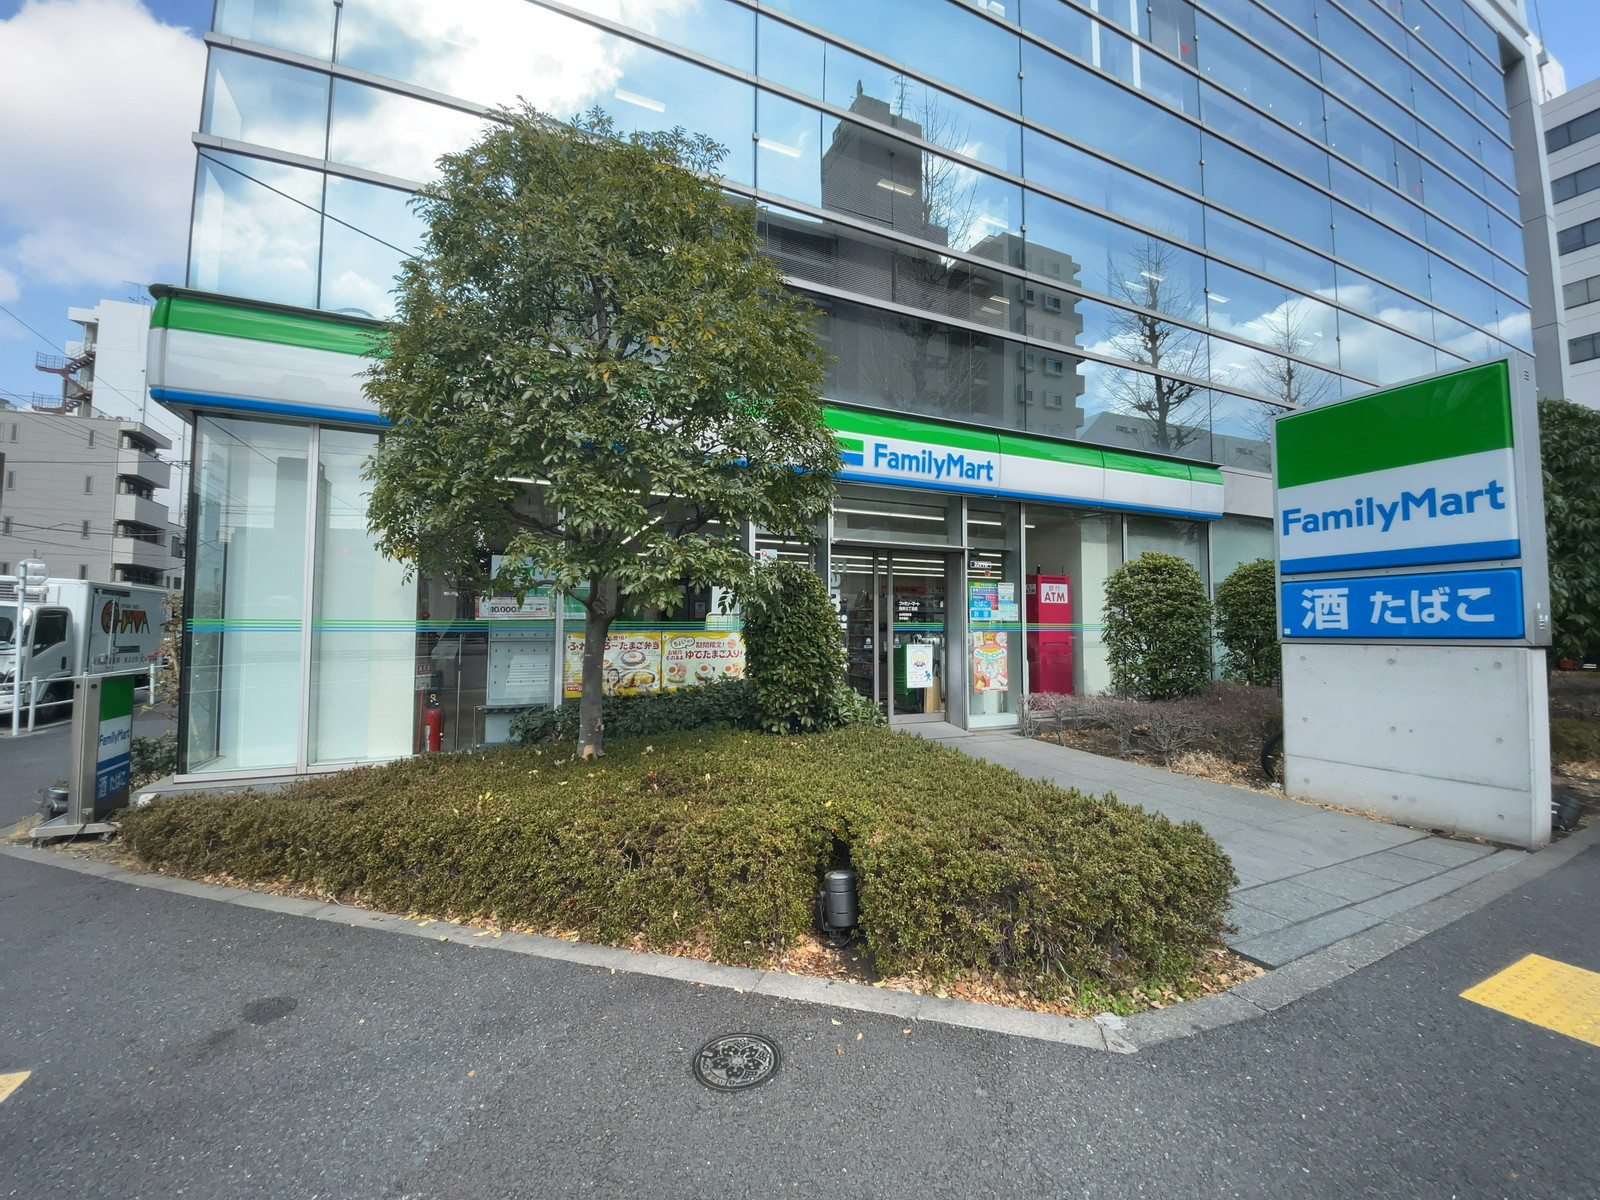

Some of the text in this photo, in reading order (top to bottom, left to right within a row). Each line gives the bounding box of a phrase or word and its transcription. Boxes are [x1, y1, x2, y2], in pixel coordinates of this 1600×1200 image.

[874, 443, 994, 481] FamilyMart
[1282, 479, 1506, 536] FamilyMart
[1044, 592, 1066, 602] ATM
[1301, 586, 1495, 630] 酒 たばこ
[685, 650, 743, 659] ゆでたまご入り!
[99, 728, 130, 746] FamilyMart
[109, 770, 127, 792] たばこ
